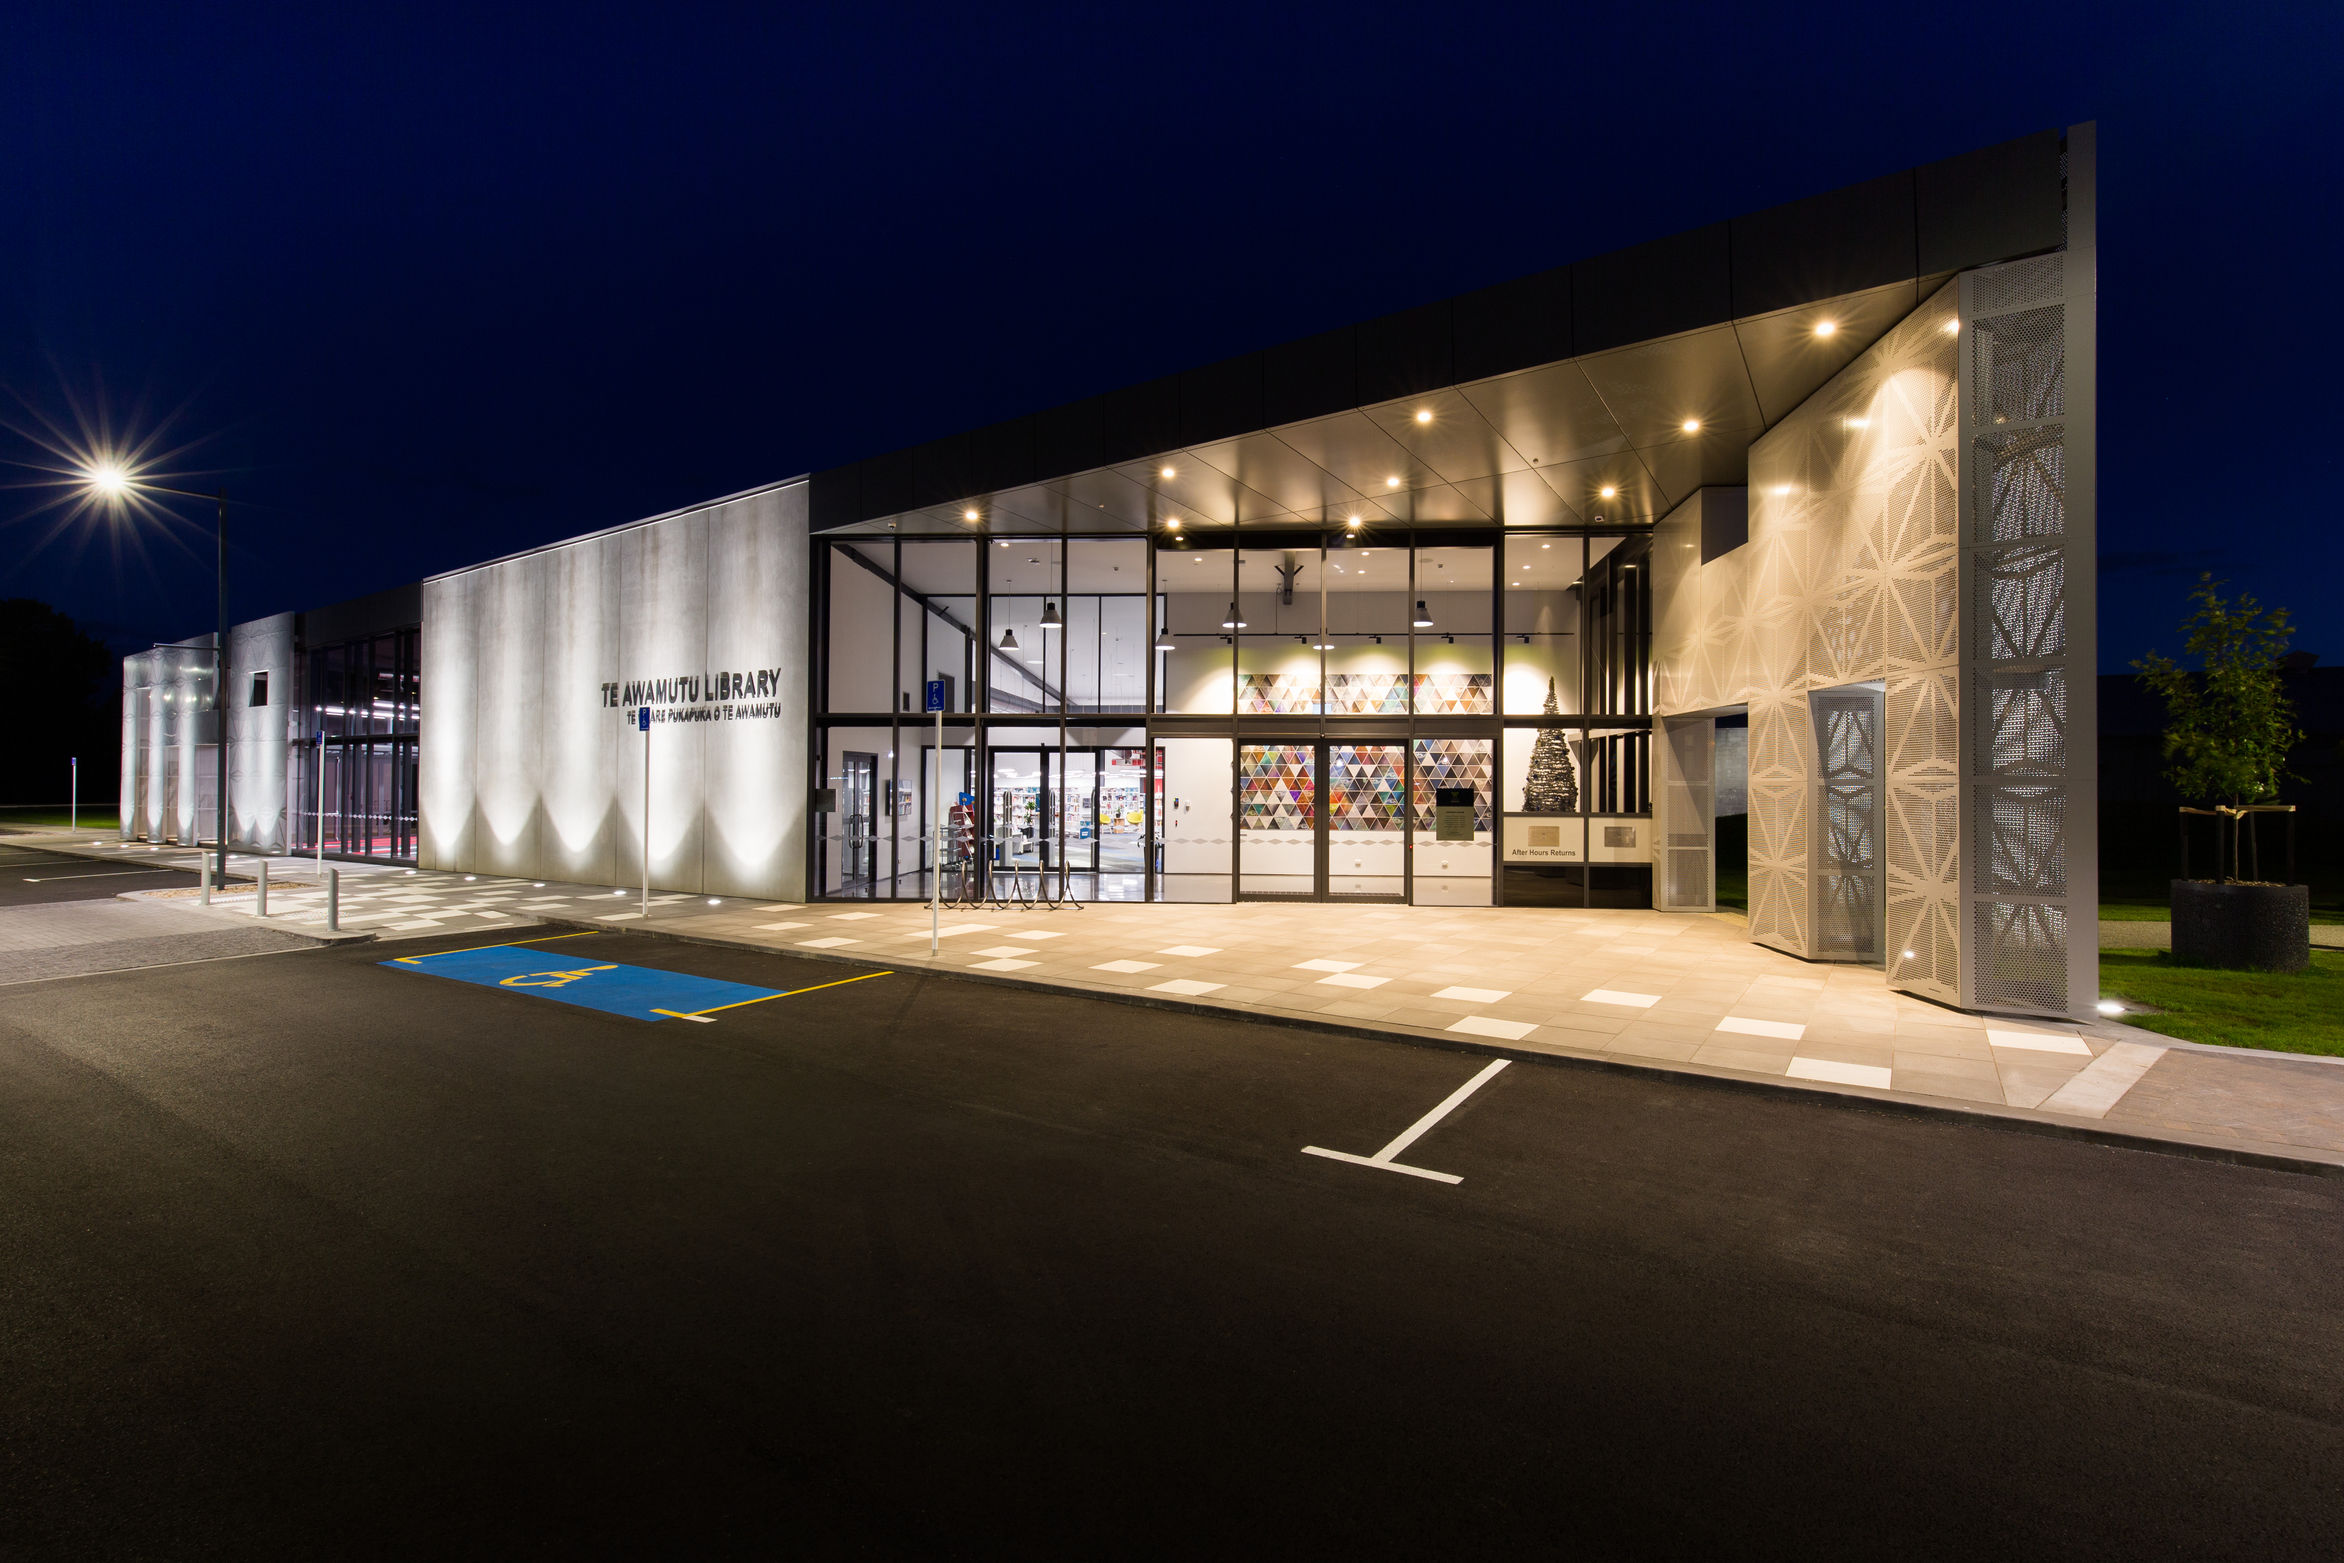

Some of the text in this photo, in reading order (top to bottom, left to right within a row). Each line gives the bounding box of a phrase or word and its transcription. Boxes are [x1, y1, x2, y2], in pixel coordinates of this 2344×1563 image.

[601, 667, 781, 707] TE AWAMUTU LIBRARY
[933, 683, 939, 693] P
[627, 709, 636, 725] TE
[667, 705, 712, 723] PUKAPUKA
[723, 704, 733, 721] TE
[735, 702, 781, 720] AWAMUTU
[1550, 849, 1576, 857] Returns
